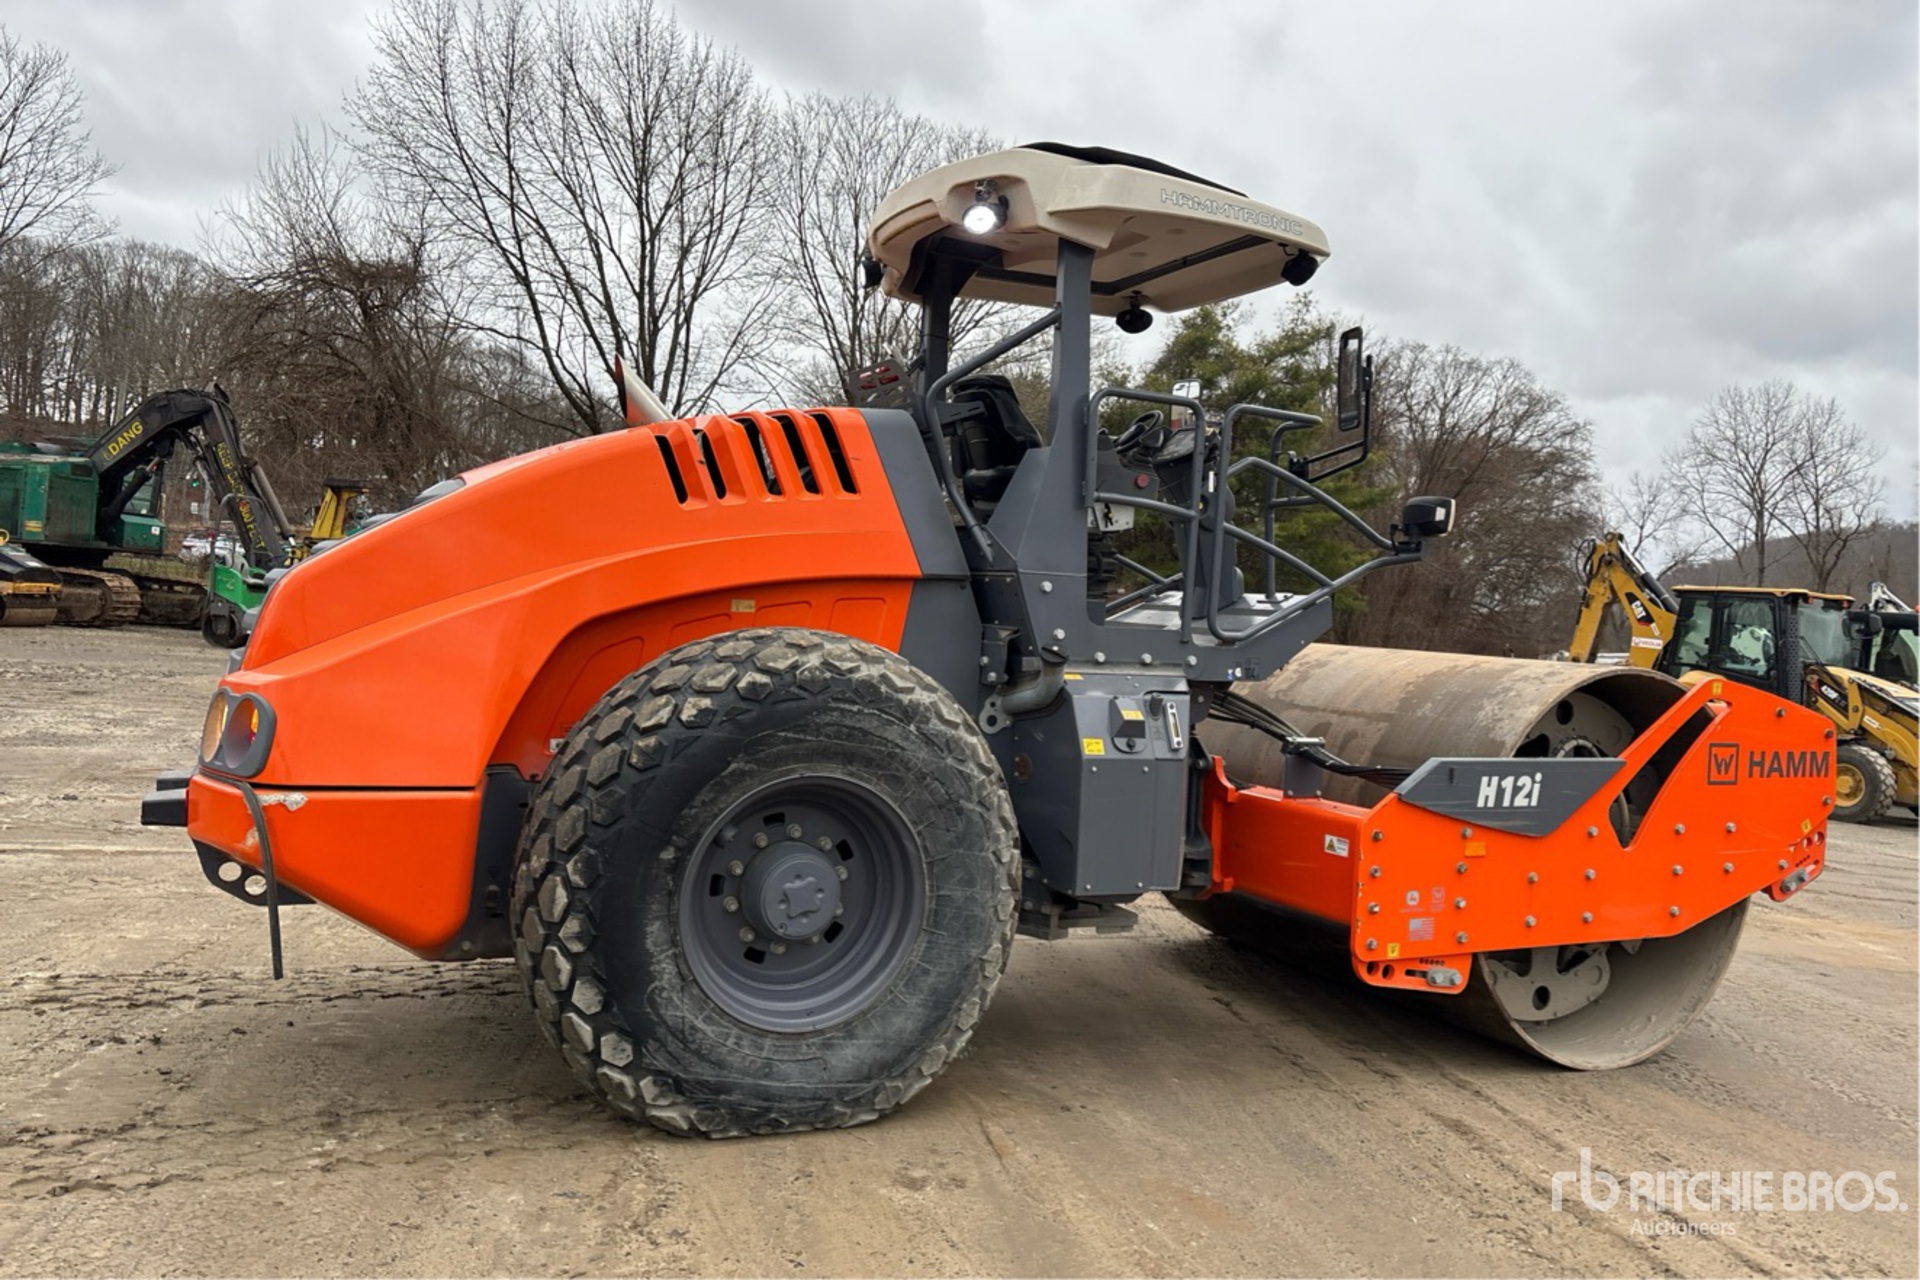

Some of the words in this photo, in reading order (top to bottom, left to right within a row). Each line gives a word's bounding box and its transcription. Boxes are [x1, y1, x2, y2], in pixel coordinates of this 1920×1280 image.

[1160, 188, 1304, 236] HAMMTRONIC
[1748, 751, 1830, 778] HAMM
[1477, 772, 1543, 808] H12i
